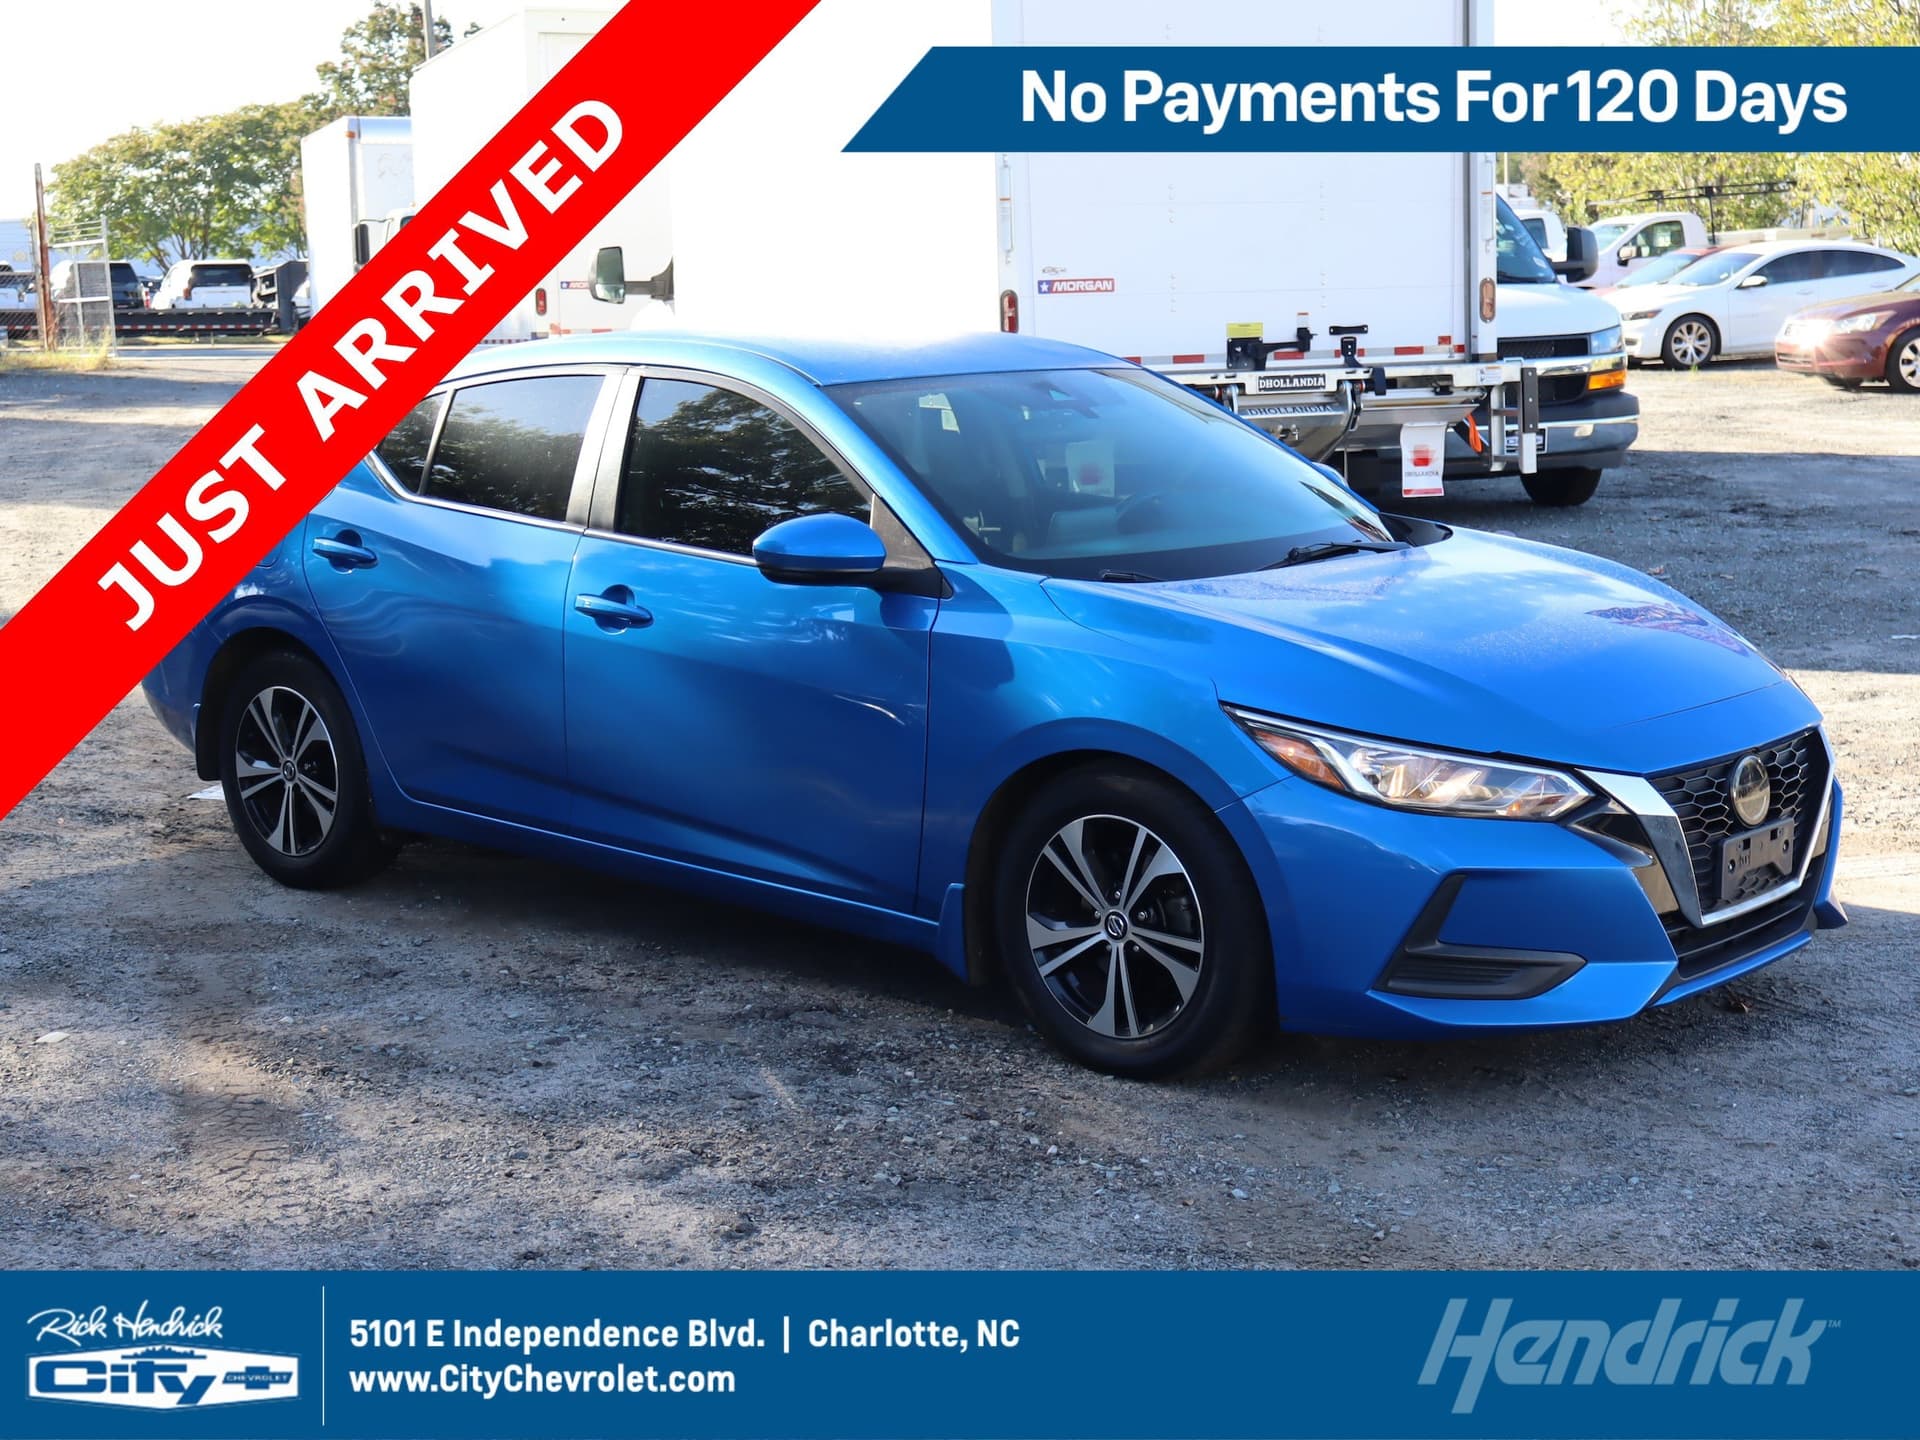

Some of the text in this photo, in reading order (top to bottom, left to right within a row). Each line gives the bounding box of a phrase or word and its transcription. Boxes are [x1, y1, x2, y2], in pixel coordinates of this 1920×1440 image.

[1052, 280, 1113, 292] MORGAN
[1259, 377, 1326, 389] DHOLLANDIA
[1248, 404, 1331, 416] DHOLLANDIA
